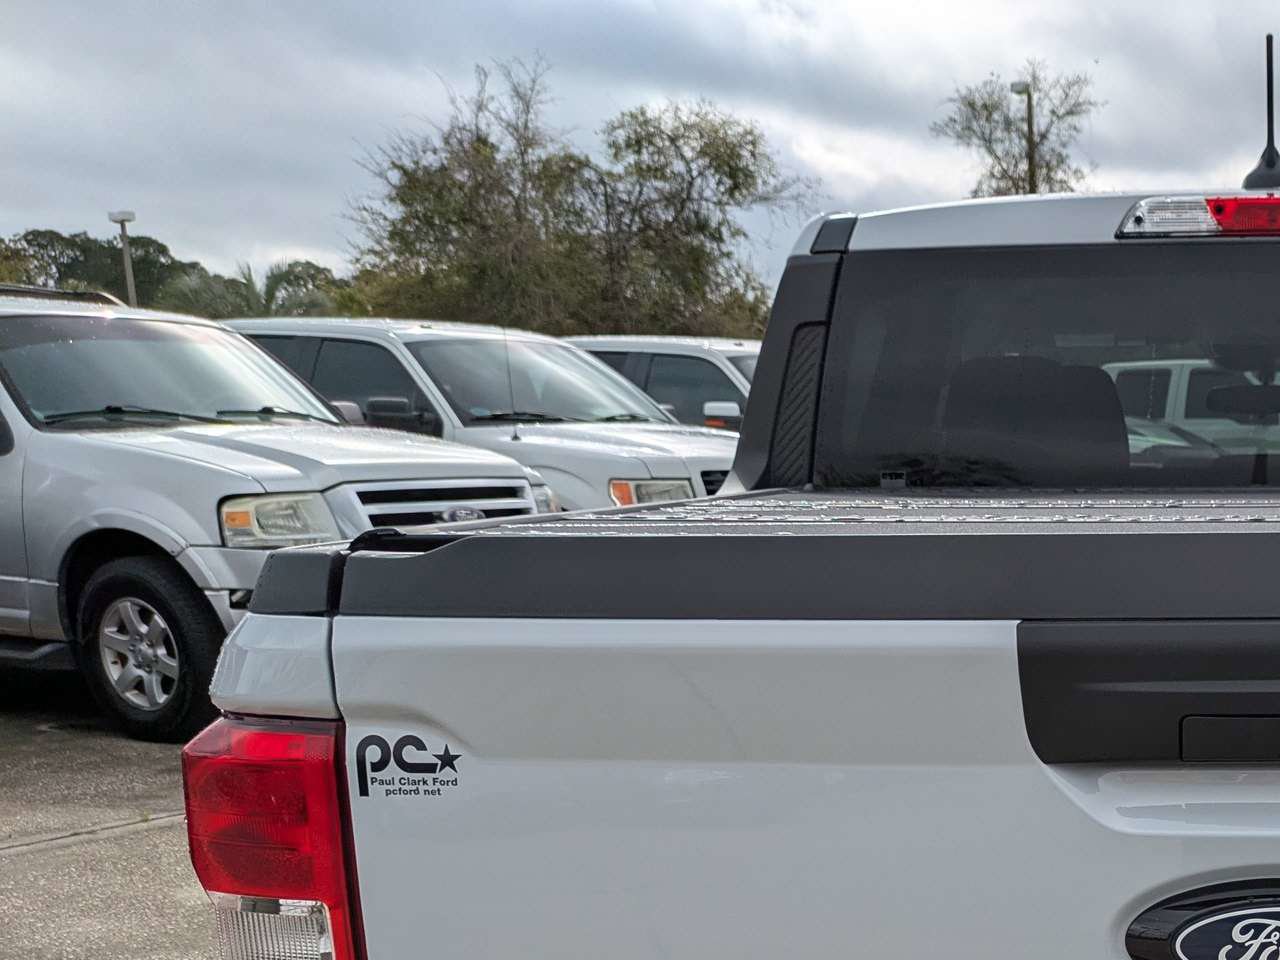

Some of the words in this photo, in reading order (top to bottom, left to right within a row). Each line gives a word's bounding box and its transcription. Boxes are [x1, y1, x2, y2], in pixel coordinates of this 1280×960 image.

[371, 776, 395, 786] Paul
[399, 776, 429, 786] Clark
[432, 776, 458, 787] Ford
